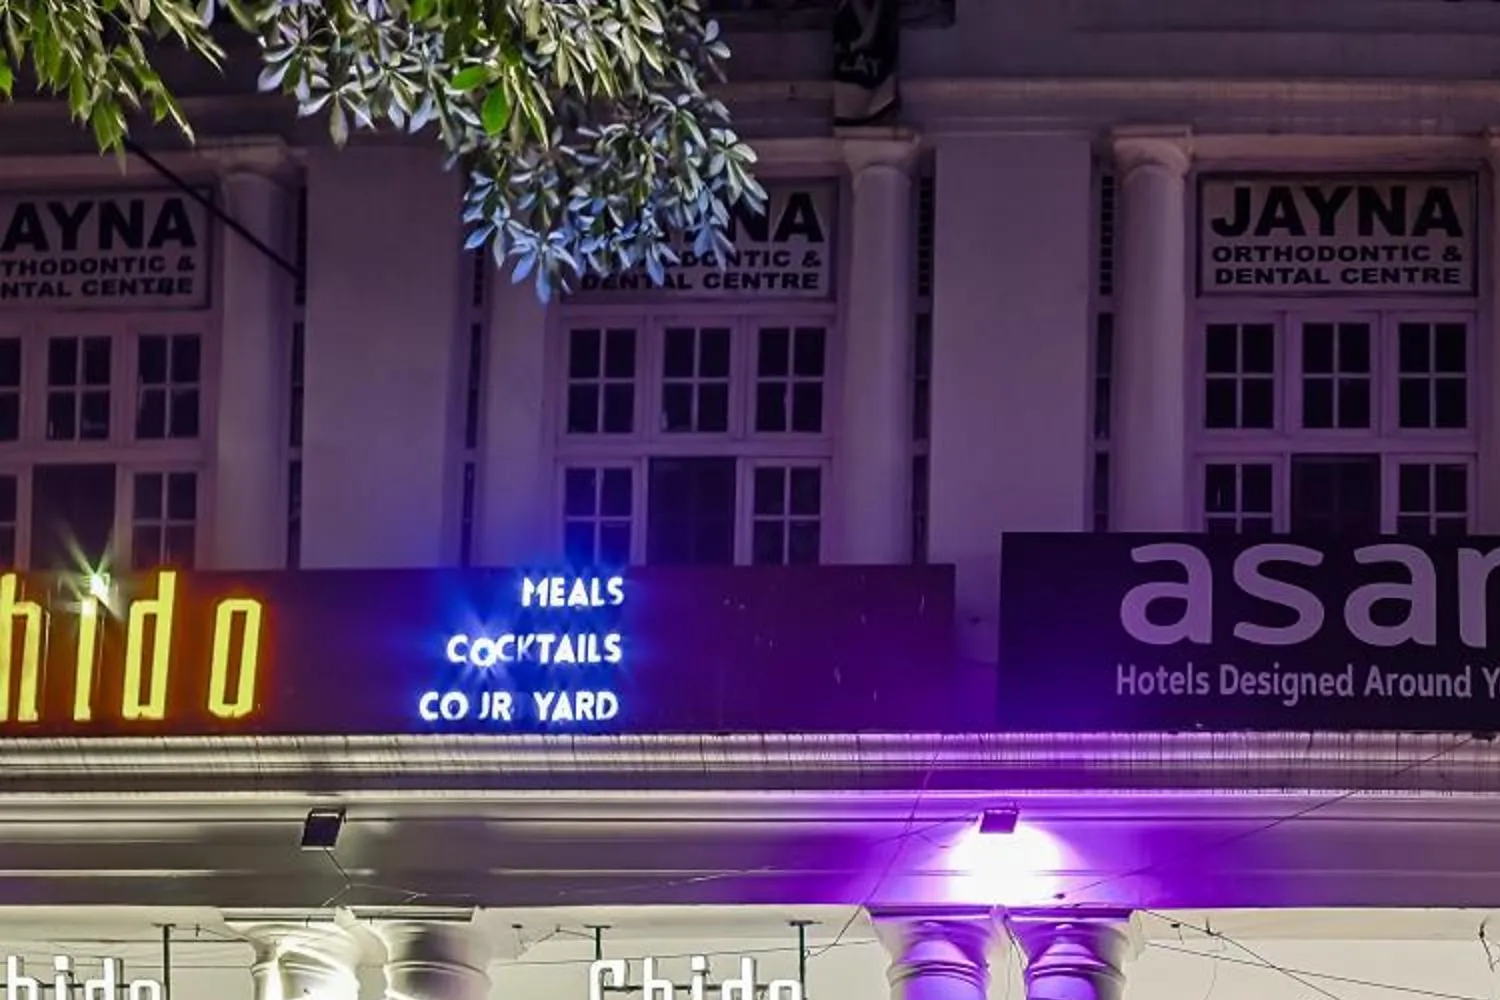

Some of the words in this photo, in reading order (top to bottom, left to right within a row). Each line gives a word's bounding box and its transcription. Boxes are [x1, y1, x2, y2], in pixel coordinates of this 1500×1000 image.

[1211, 185, 1464, 238] JAYNA
[1, 198, 197, 251] AYNA
[177, 254, 196, 273] &
[801, 250, 822, 268] &
[1212, 245, 1430, 263] ORTHODONTIC
[1442, 246, 1463, 263] &
[81, 277, 193, 296] CENTRE
[703, 272, 820, 290] CENTRE
[1215, 268, 1331, 285] DENTAL
[1340, 268, 1462, 285] CENTRE
[521, 576, 625, 608] MEALS
[0, 570, 262, 722] hido
[446, 632, 623, 668] COCKTAILS
[1116, 662, 1209, 696] Hotels
[1220, 662, 1354, 707] Designed
[1364, 664, 1472, 699] Around
